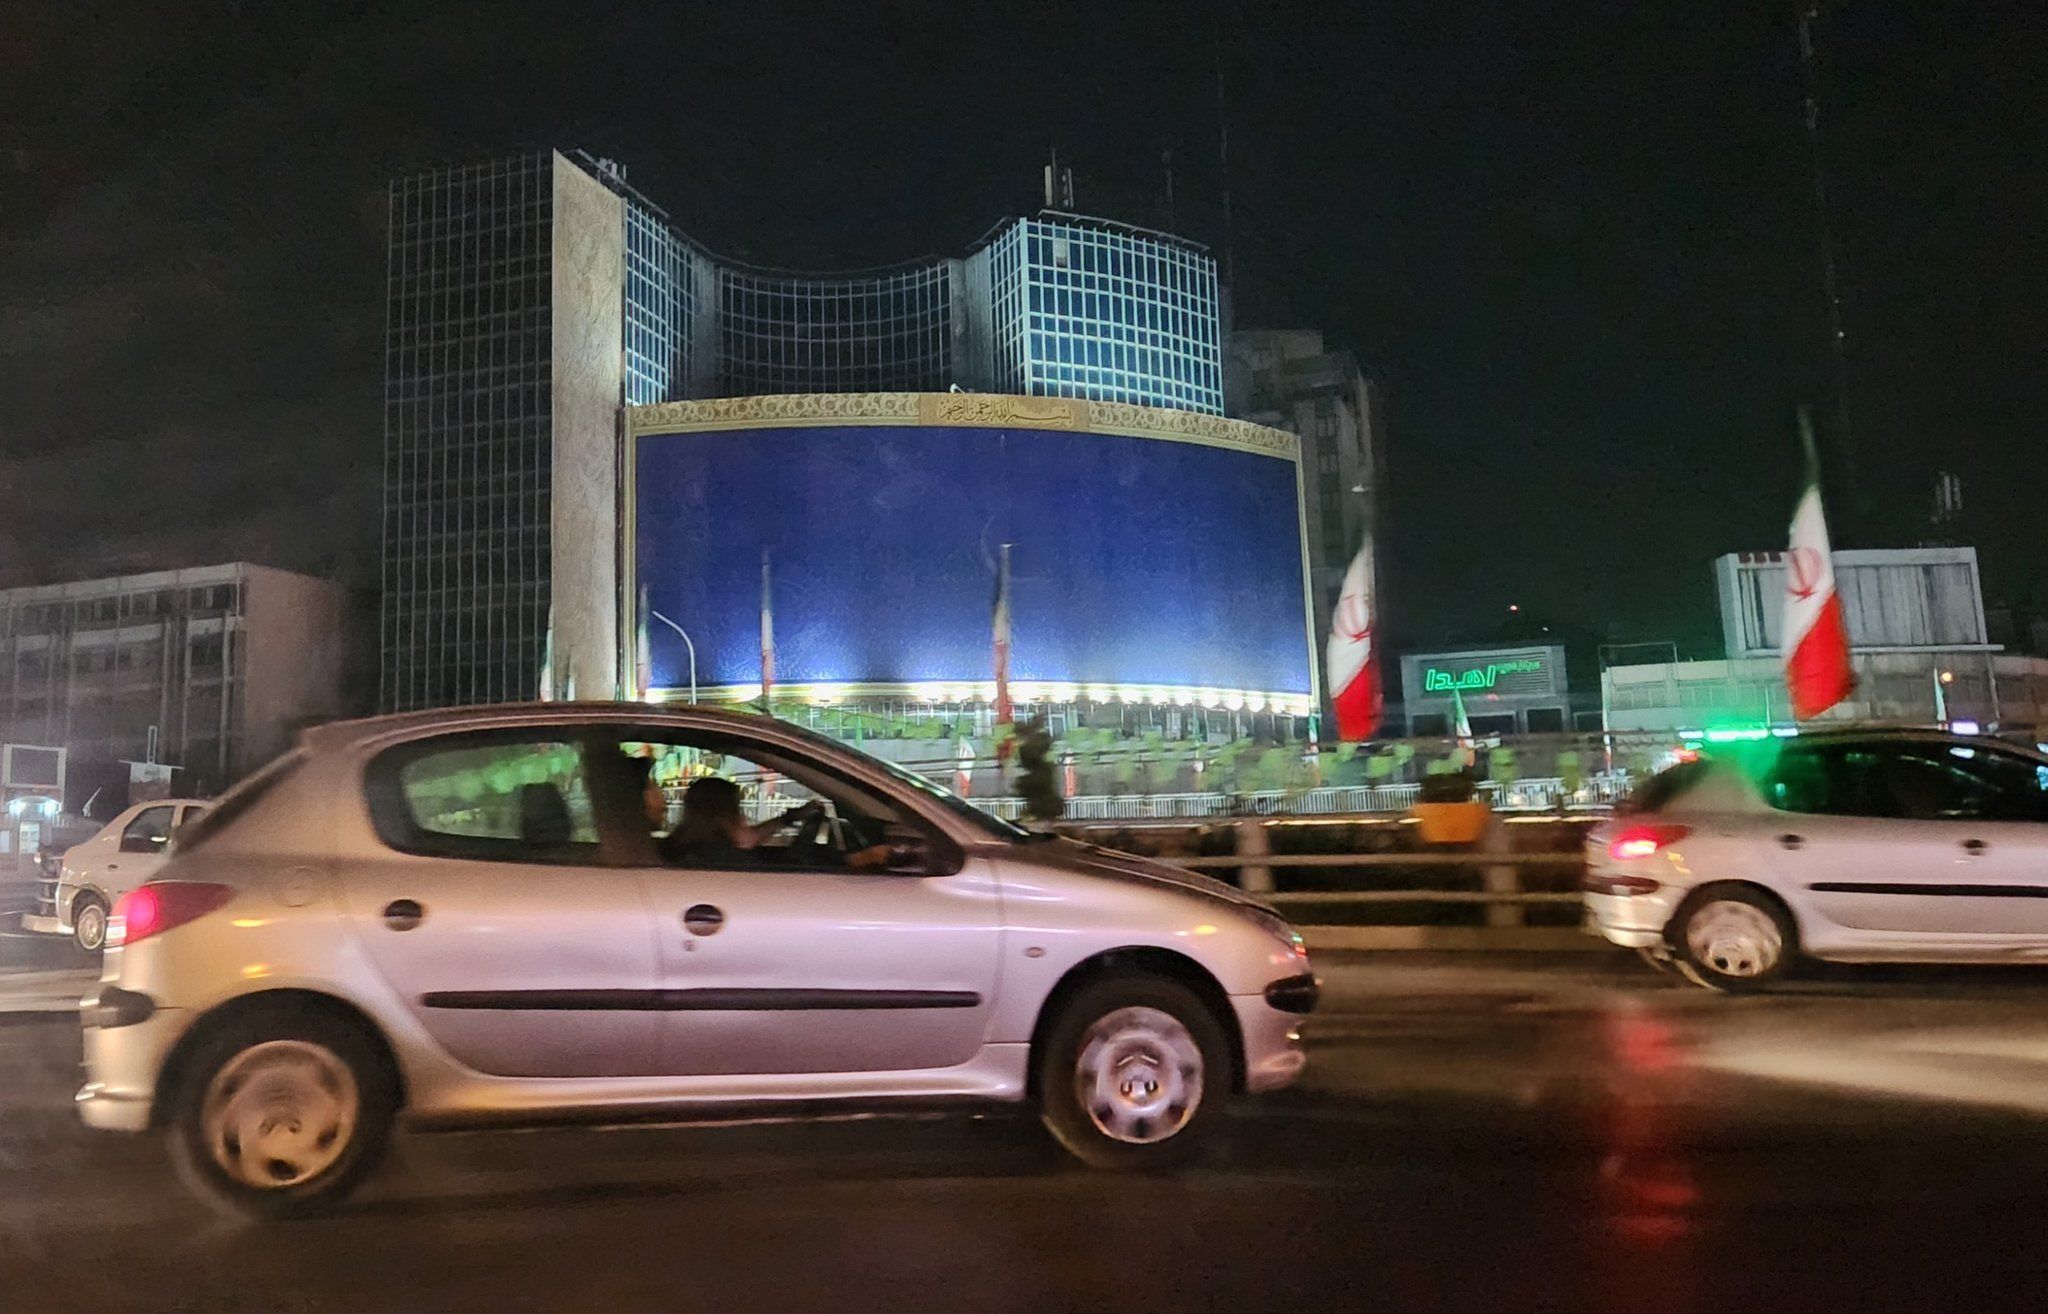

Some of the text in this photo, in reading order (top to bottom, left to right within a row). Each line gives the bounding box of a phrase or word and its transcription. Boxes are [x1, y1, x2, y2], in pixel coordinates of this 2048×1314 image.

[965, 399, 995, 422] الرحمن
[1005, 408, 1073, 424] بسم
[1426, 665, 1496, 691] اهدا
